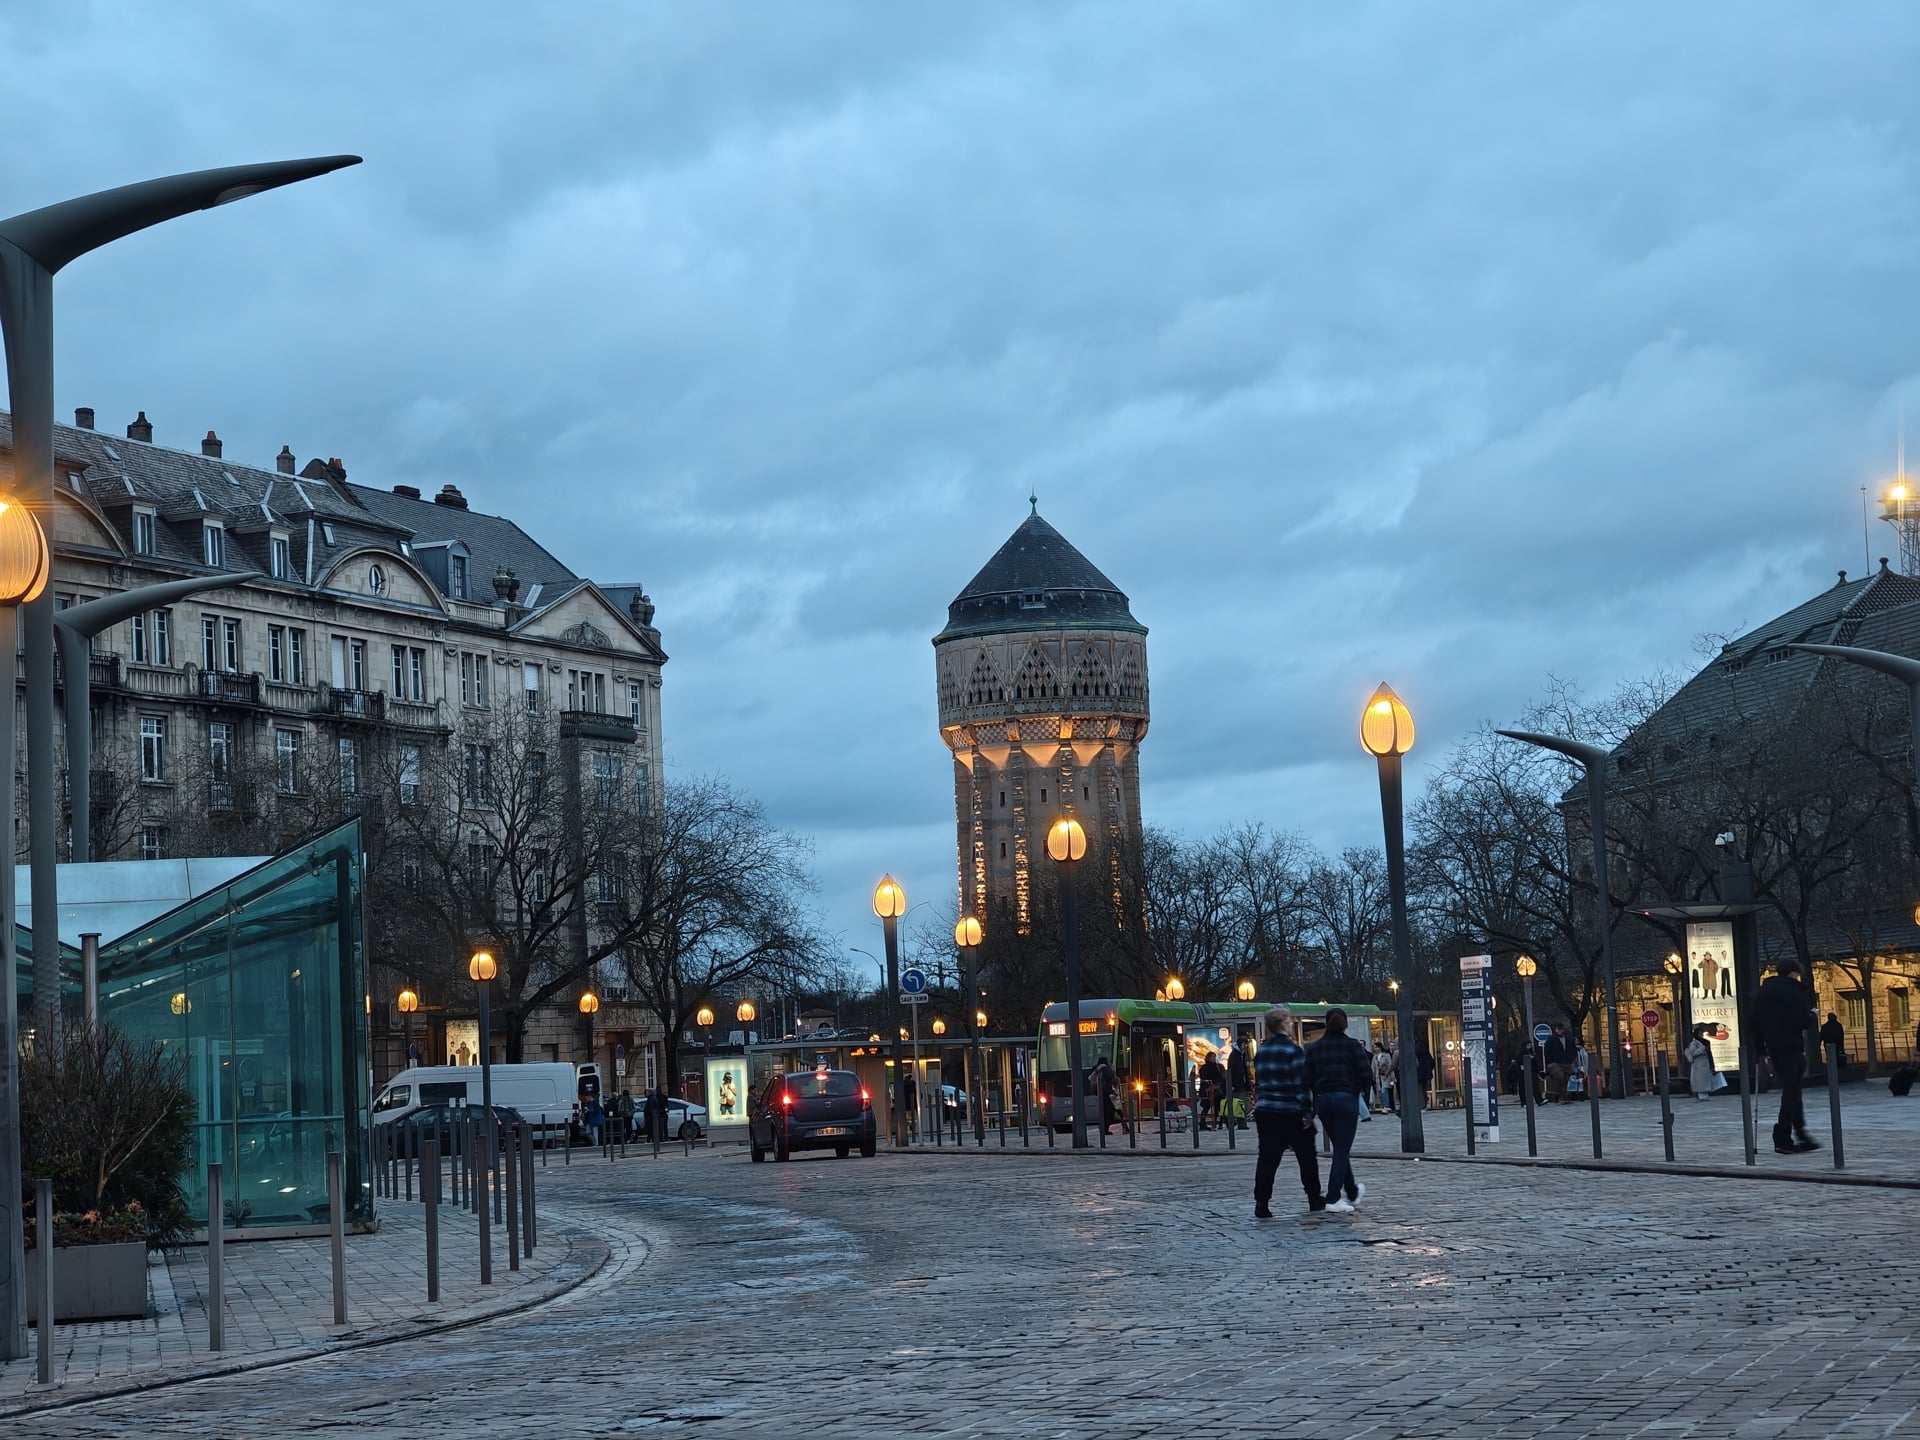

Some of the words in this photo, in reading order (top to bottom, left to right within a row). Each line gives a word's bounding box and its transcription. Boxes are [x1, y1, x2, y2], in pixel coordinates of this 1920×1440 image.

[1693, 1007, 1736, 1017] MAIGRET
[1079, 1021, 1097, 1032] ORNY
[1484, 971, 1496, 1117] INFORMATIONS
